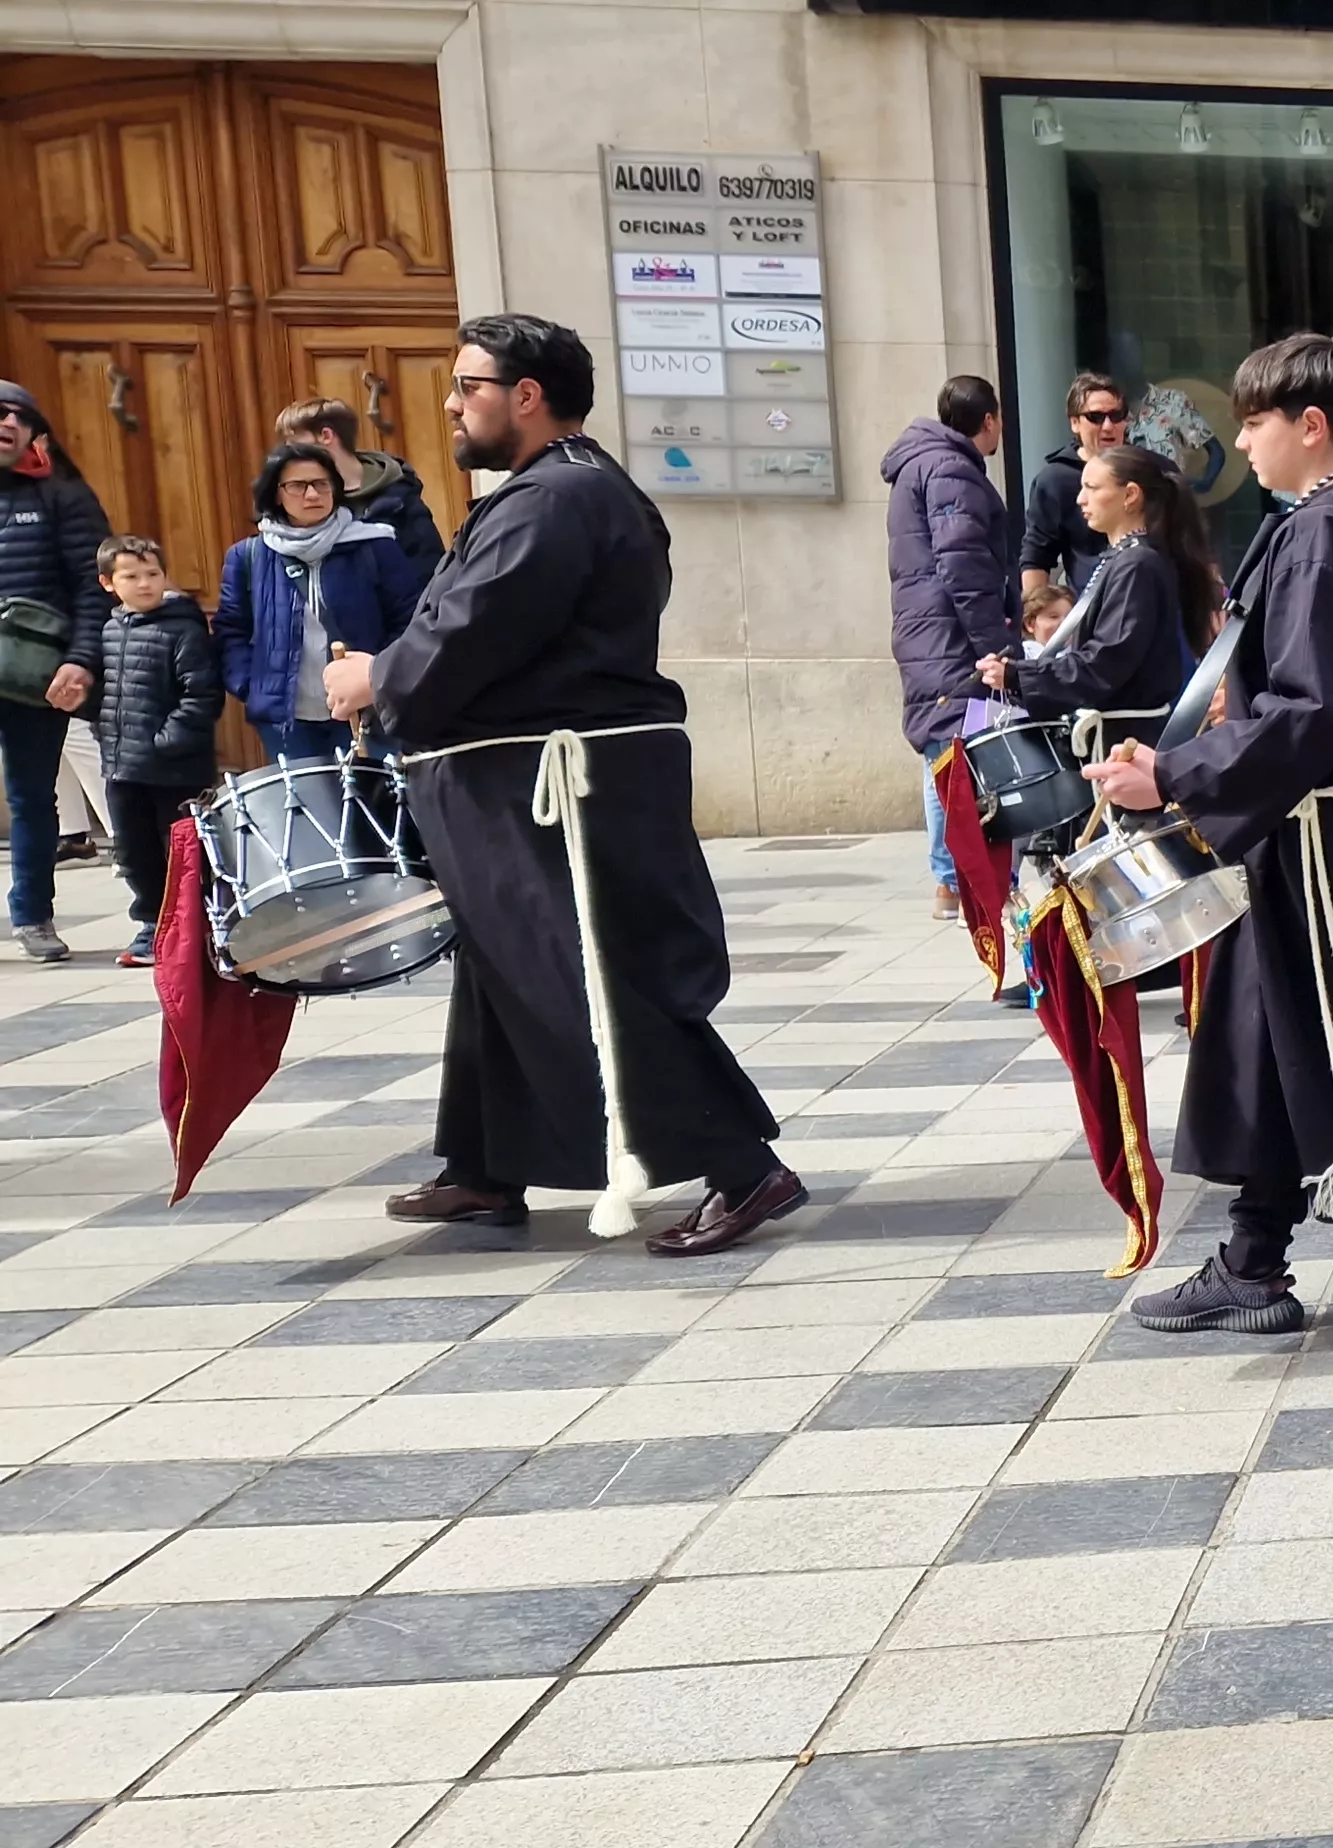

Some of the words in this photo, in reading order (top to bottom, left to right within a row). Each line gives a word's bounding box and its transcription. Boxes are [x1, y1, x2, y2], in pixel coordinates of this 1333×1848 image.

[614, 165, 701, 193] ALQUILO
[718, 176, 815, 201] 639770319
[618, 219, 707, 236] OFICINAS
[728, 216, 804, 228] ATICOS
[732, 231, 744, 242] Y
[752, 231, 802, 243] LOFT
[741, 317, 811, 332] ORDESA
